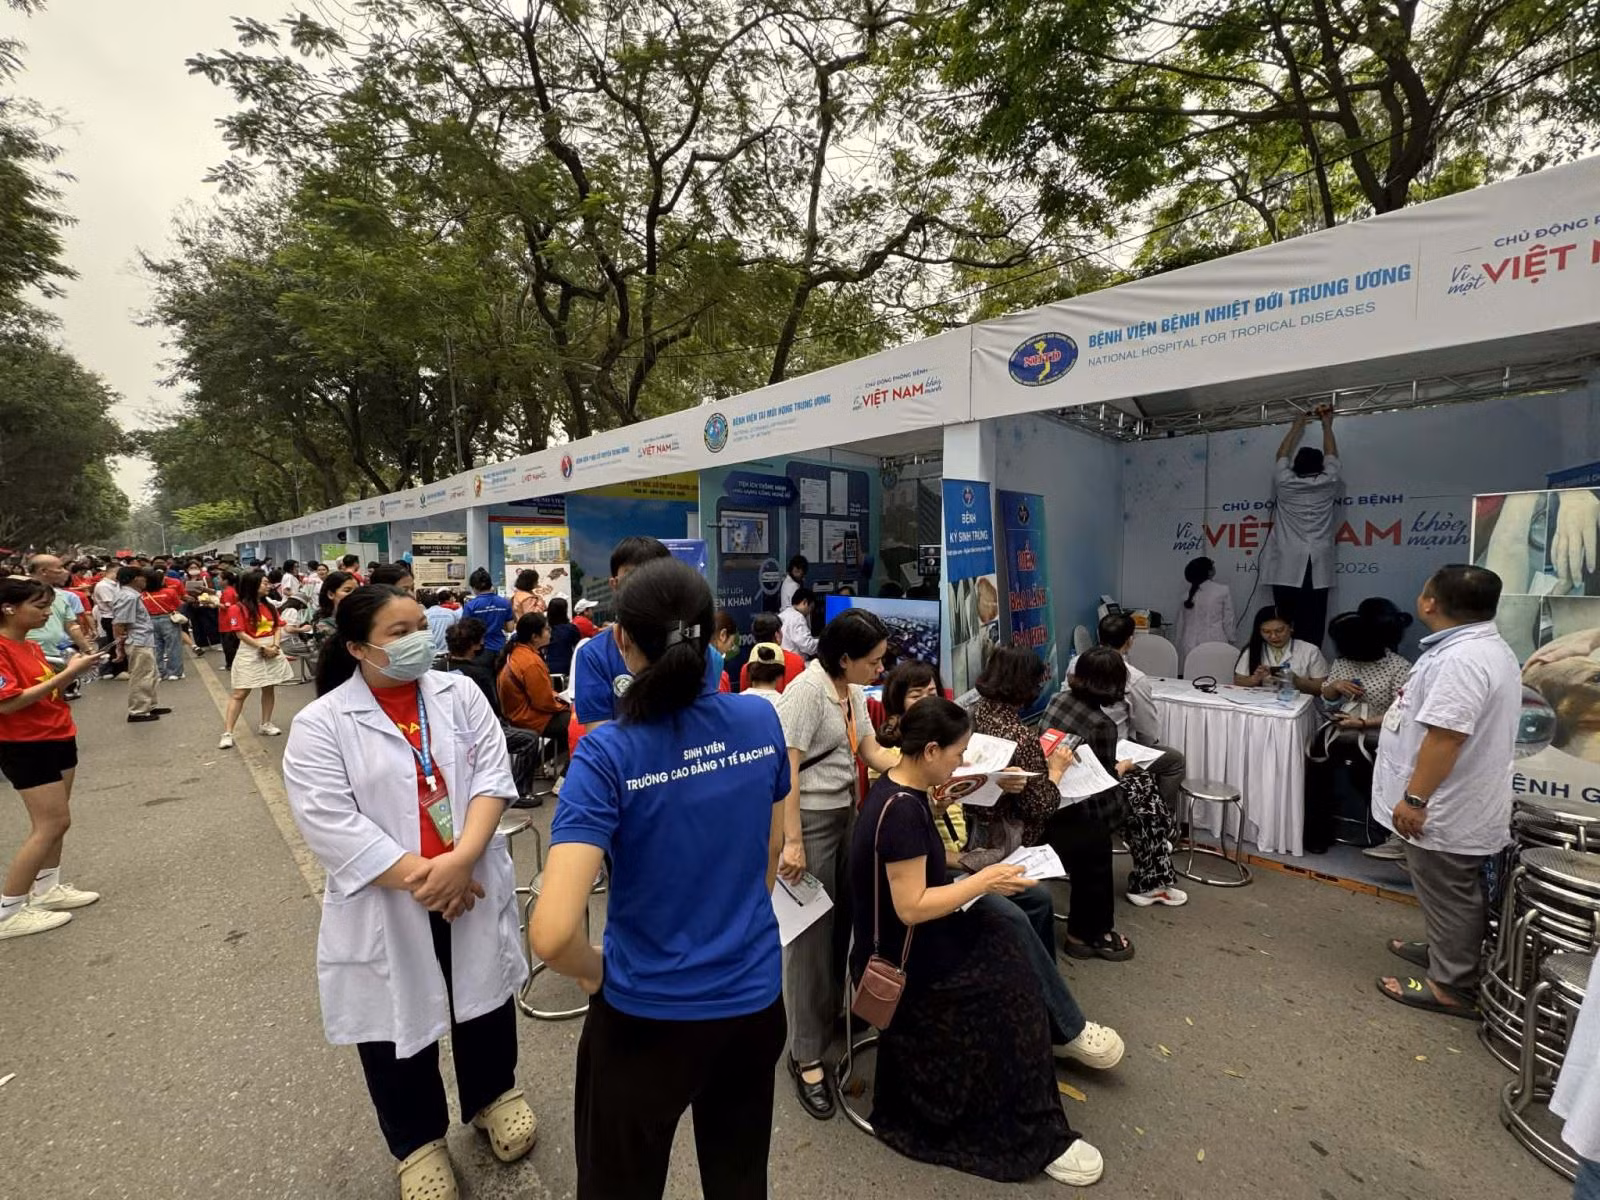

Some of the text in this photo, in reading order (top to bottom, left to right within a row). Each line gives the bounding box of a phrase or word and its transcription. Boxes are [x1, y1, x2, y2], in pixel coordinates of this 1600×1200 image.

[1494, 230, 1530, 248] CHỦ
[1535, 217, 1589, 239] ĐỘNG
[1482, 243, 1577, 284] VIỆT
[1088, 329, 1123, 350] BỆNH
[1126, 321, 1157, 341] VIỆN
[1161, 312, 1200, 334] BỆNH
[1204, 299, 1250, 323] NHIỆT
[1254, 290, 1283, 313] ĐỚI
[1288, 278, 1349, 306] TRUNG
[1355, 264, 1411, 292] ƯƠNG
[1088, 301, 1376, 367] NATIONAL HOSPITAL FOR TROPICAL DISEASES
[862, 382, 924, 409] VIỆT NAM
[656, 442, 672, 454] NAM
[1222, 499, 1250, 512] CHỦ
[1358, 493, 1404, 507] BỆNH
[1334, 519, 1402, 547] AM
[1335, 562, 1380, 574] 2026
[683, 740, 726, 761] SINH VIÊN
[626, 772, 669, 791] TRƯỜNG
[671, 767, 690, 780] CAO
[719, 757, 726, 768] Y
[727, 750, 739, 765] TẾ
[739, 747, 764, 764] BẠCH
[1512, 772, 1570, 799] ỆNH
